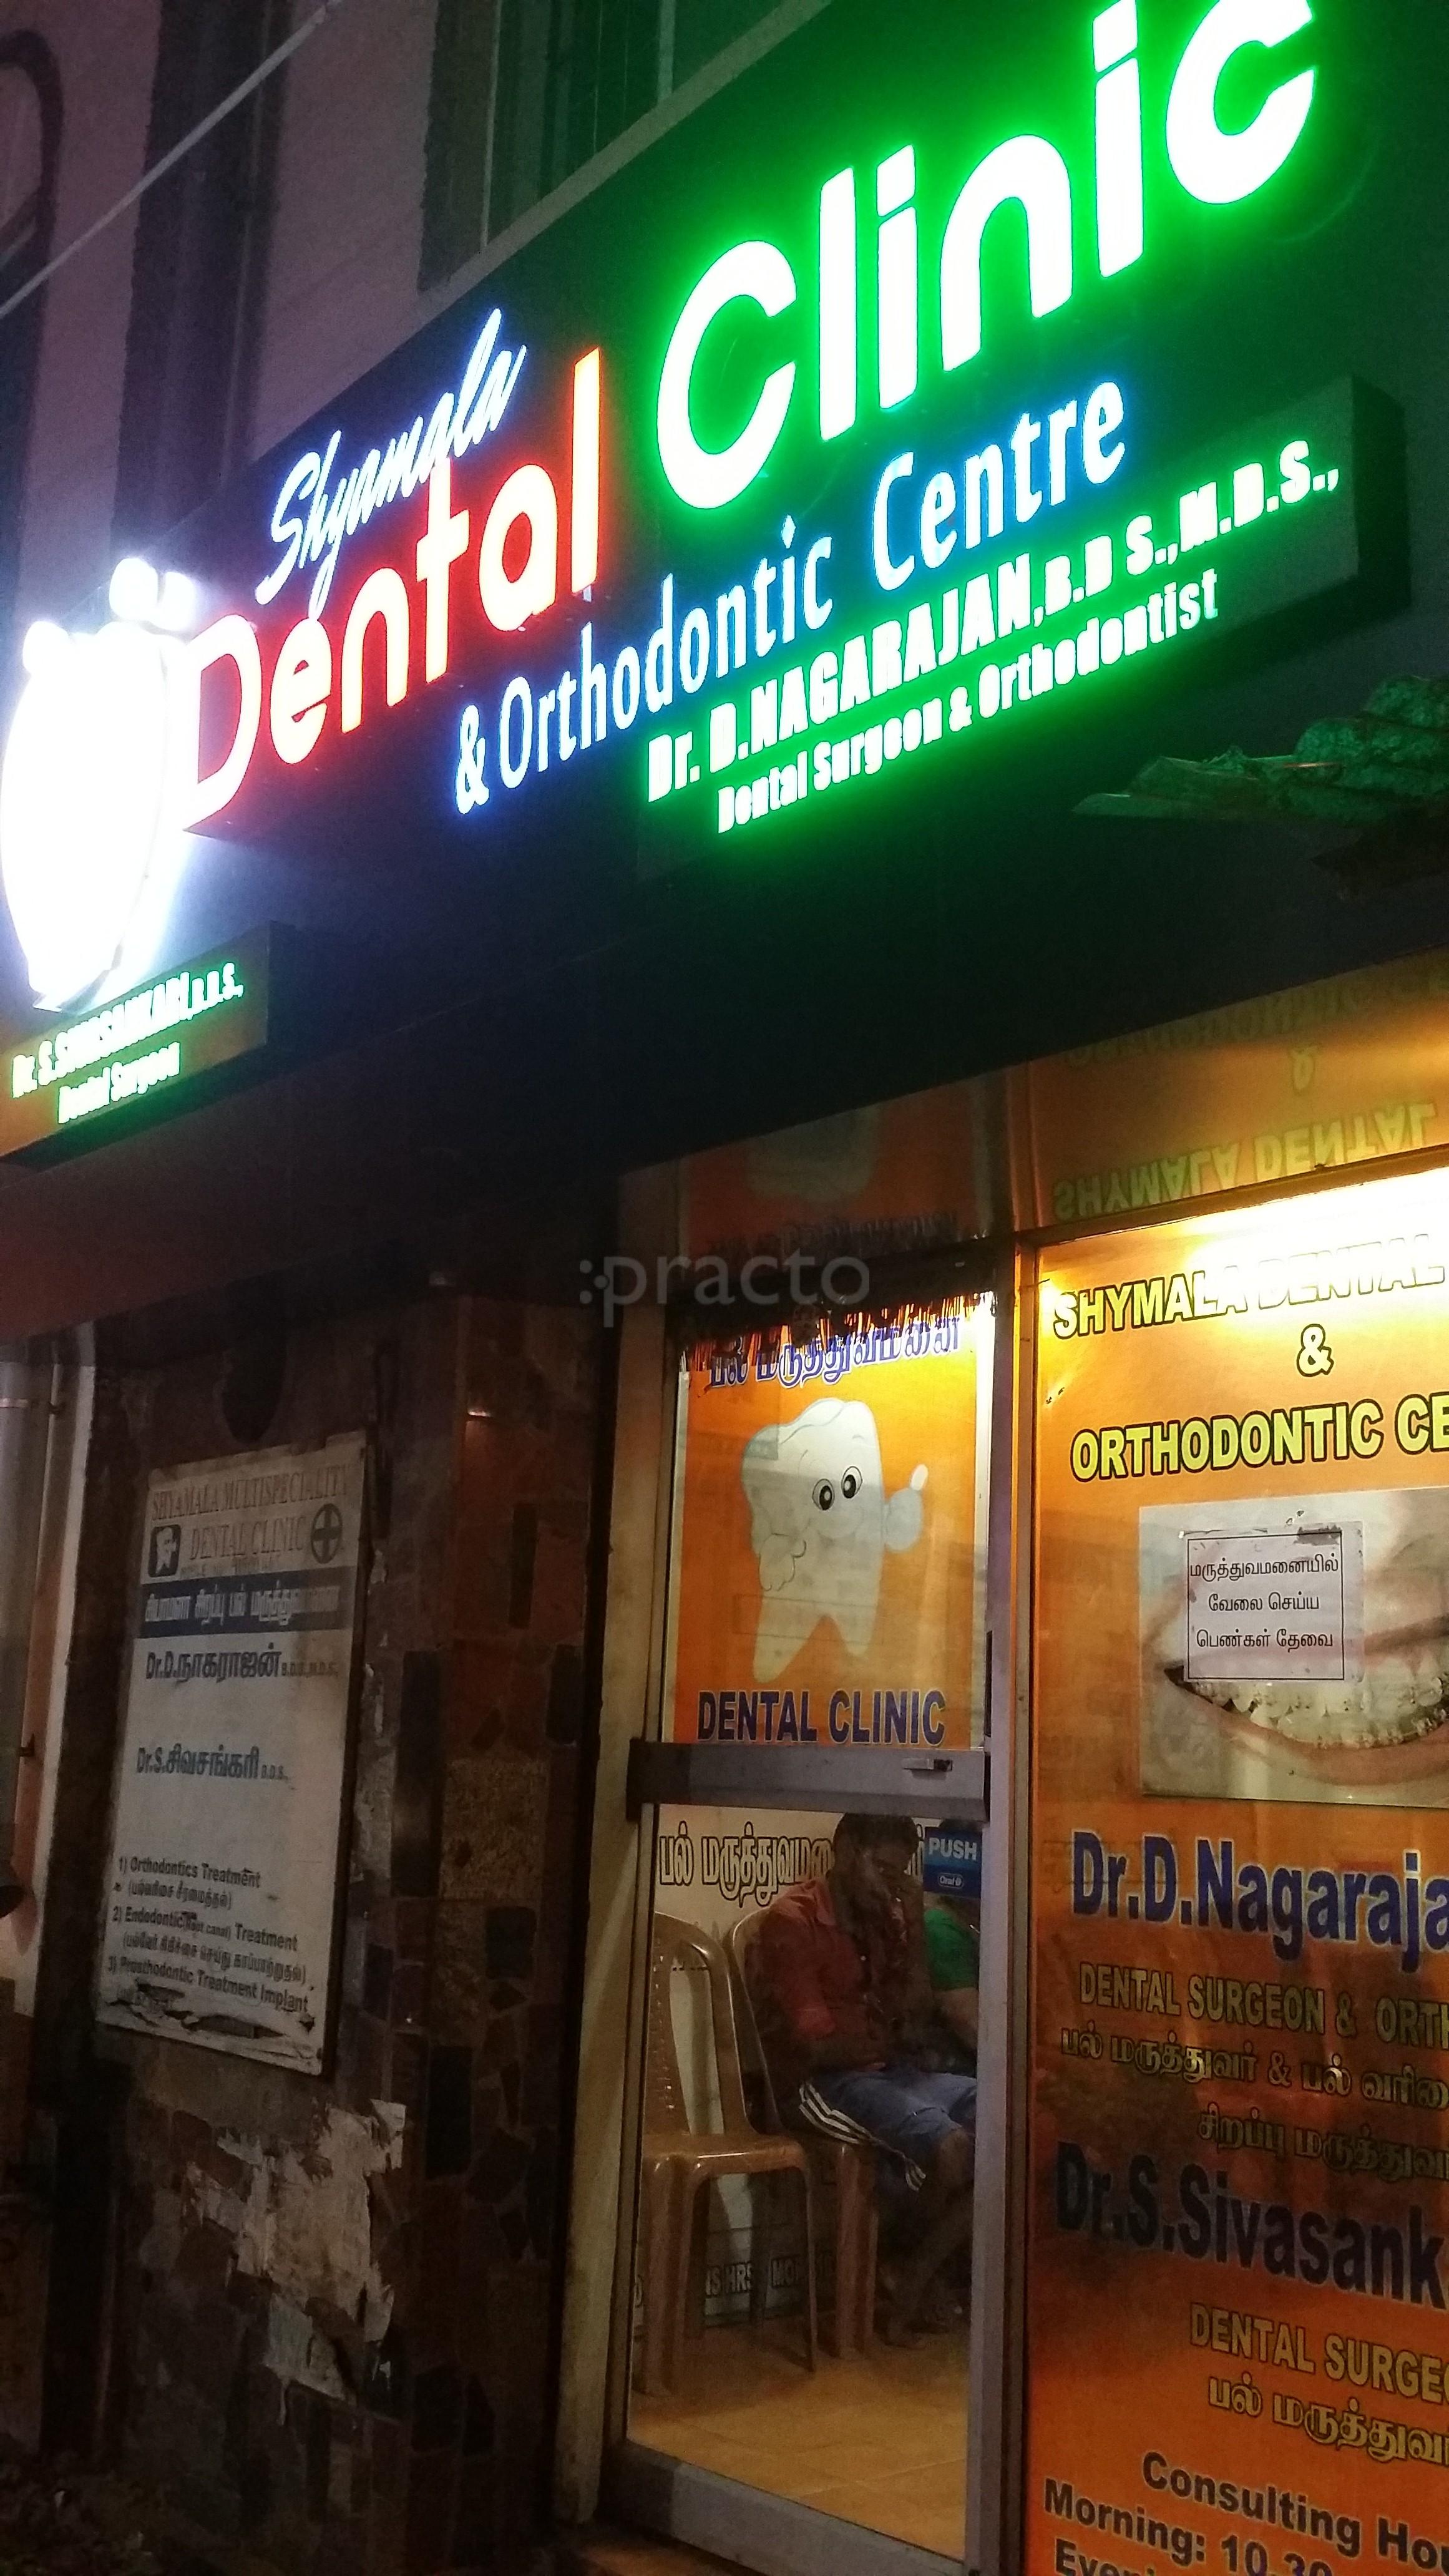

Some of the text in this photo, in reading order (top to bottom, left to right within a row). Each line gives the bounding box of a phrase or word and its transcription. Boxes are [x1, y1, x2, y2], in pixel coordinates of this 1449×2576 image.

[656, 0, 1315, 509] Clinic
[256, 308, 526, 621] Shyamala
[183, 346, 601, 831] Dental
[455, 381, 1125, 814] & Orthodontic Centre
[718, 568, 1218, 834] Dental Surgeon & Orthodontist
[648, 731, 700, 803] Dr.
[1053, 1265, 1248, 1339] SHYMALA
[1296, 1324, 1334, 1377] &
[1070, 1398, 1383, 1483] ORTHODONTIC
[1190, 1553, 1339, 1581] மருத்துவமனையில்
[1208, 1591, 1320, 1611] வேலை செய்ய
[1196, 1628, 1333, 1652] பெண்கள் தேவை
[696, 1689, 946, 1745] DENTAL CLINIC
[130, 1856, 198, 1877] Orthodontics
[202, 1863, 260, 1888] Treatment
[659, 1820, 694, 1886] பல்
[929, 1837, 977, 1861] PUSH
[235, 1923, 298, 1951] Treatment
[197, 1969, 257, 1999] Treatment
[260, 1984, 308, 2014] Implant
[1080, 1962, 1181, 2016] DENTAL
[1188, 1974, 1325, 2034] SURGEON
[1334, 1993, 1358, 2037] &
[1061, 2020, 1104, 2059] பல்
[1111, 2031, 1259, 2084] மருத்துவர்
[1267, 2051, 1292, 2087] &
[1300, 2054, 1352, 2095] பல்
[1197, 2102, 1286, 2156] சிறப்பு
[1189, 2302, 1315, 2374] DENTAL
[1209, 2372, 1262, 2417] பல்
[1043, 2477, 1206, 2567] Morning:
[1142, 2451, 1360, 2559] Consulting
